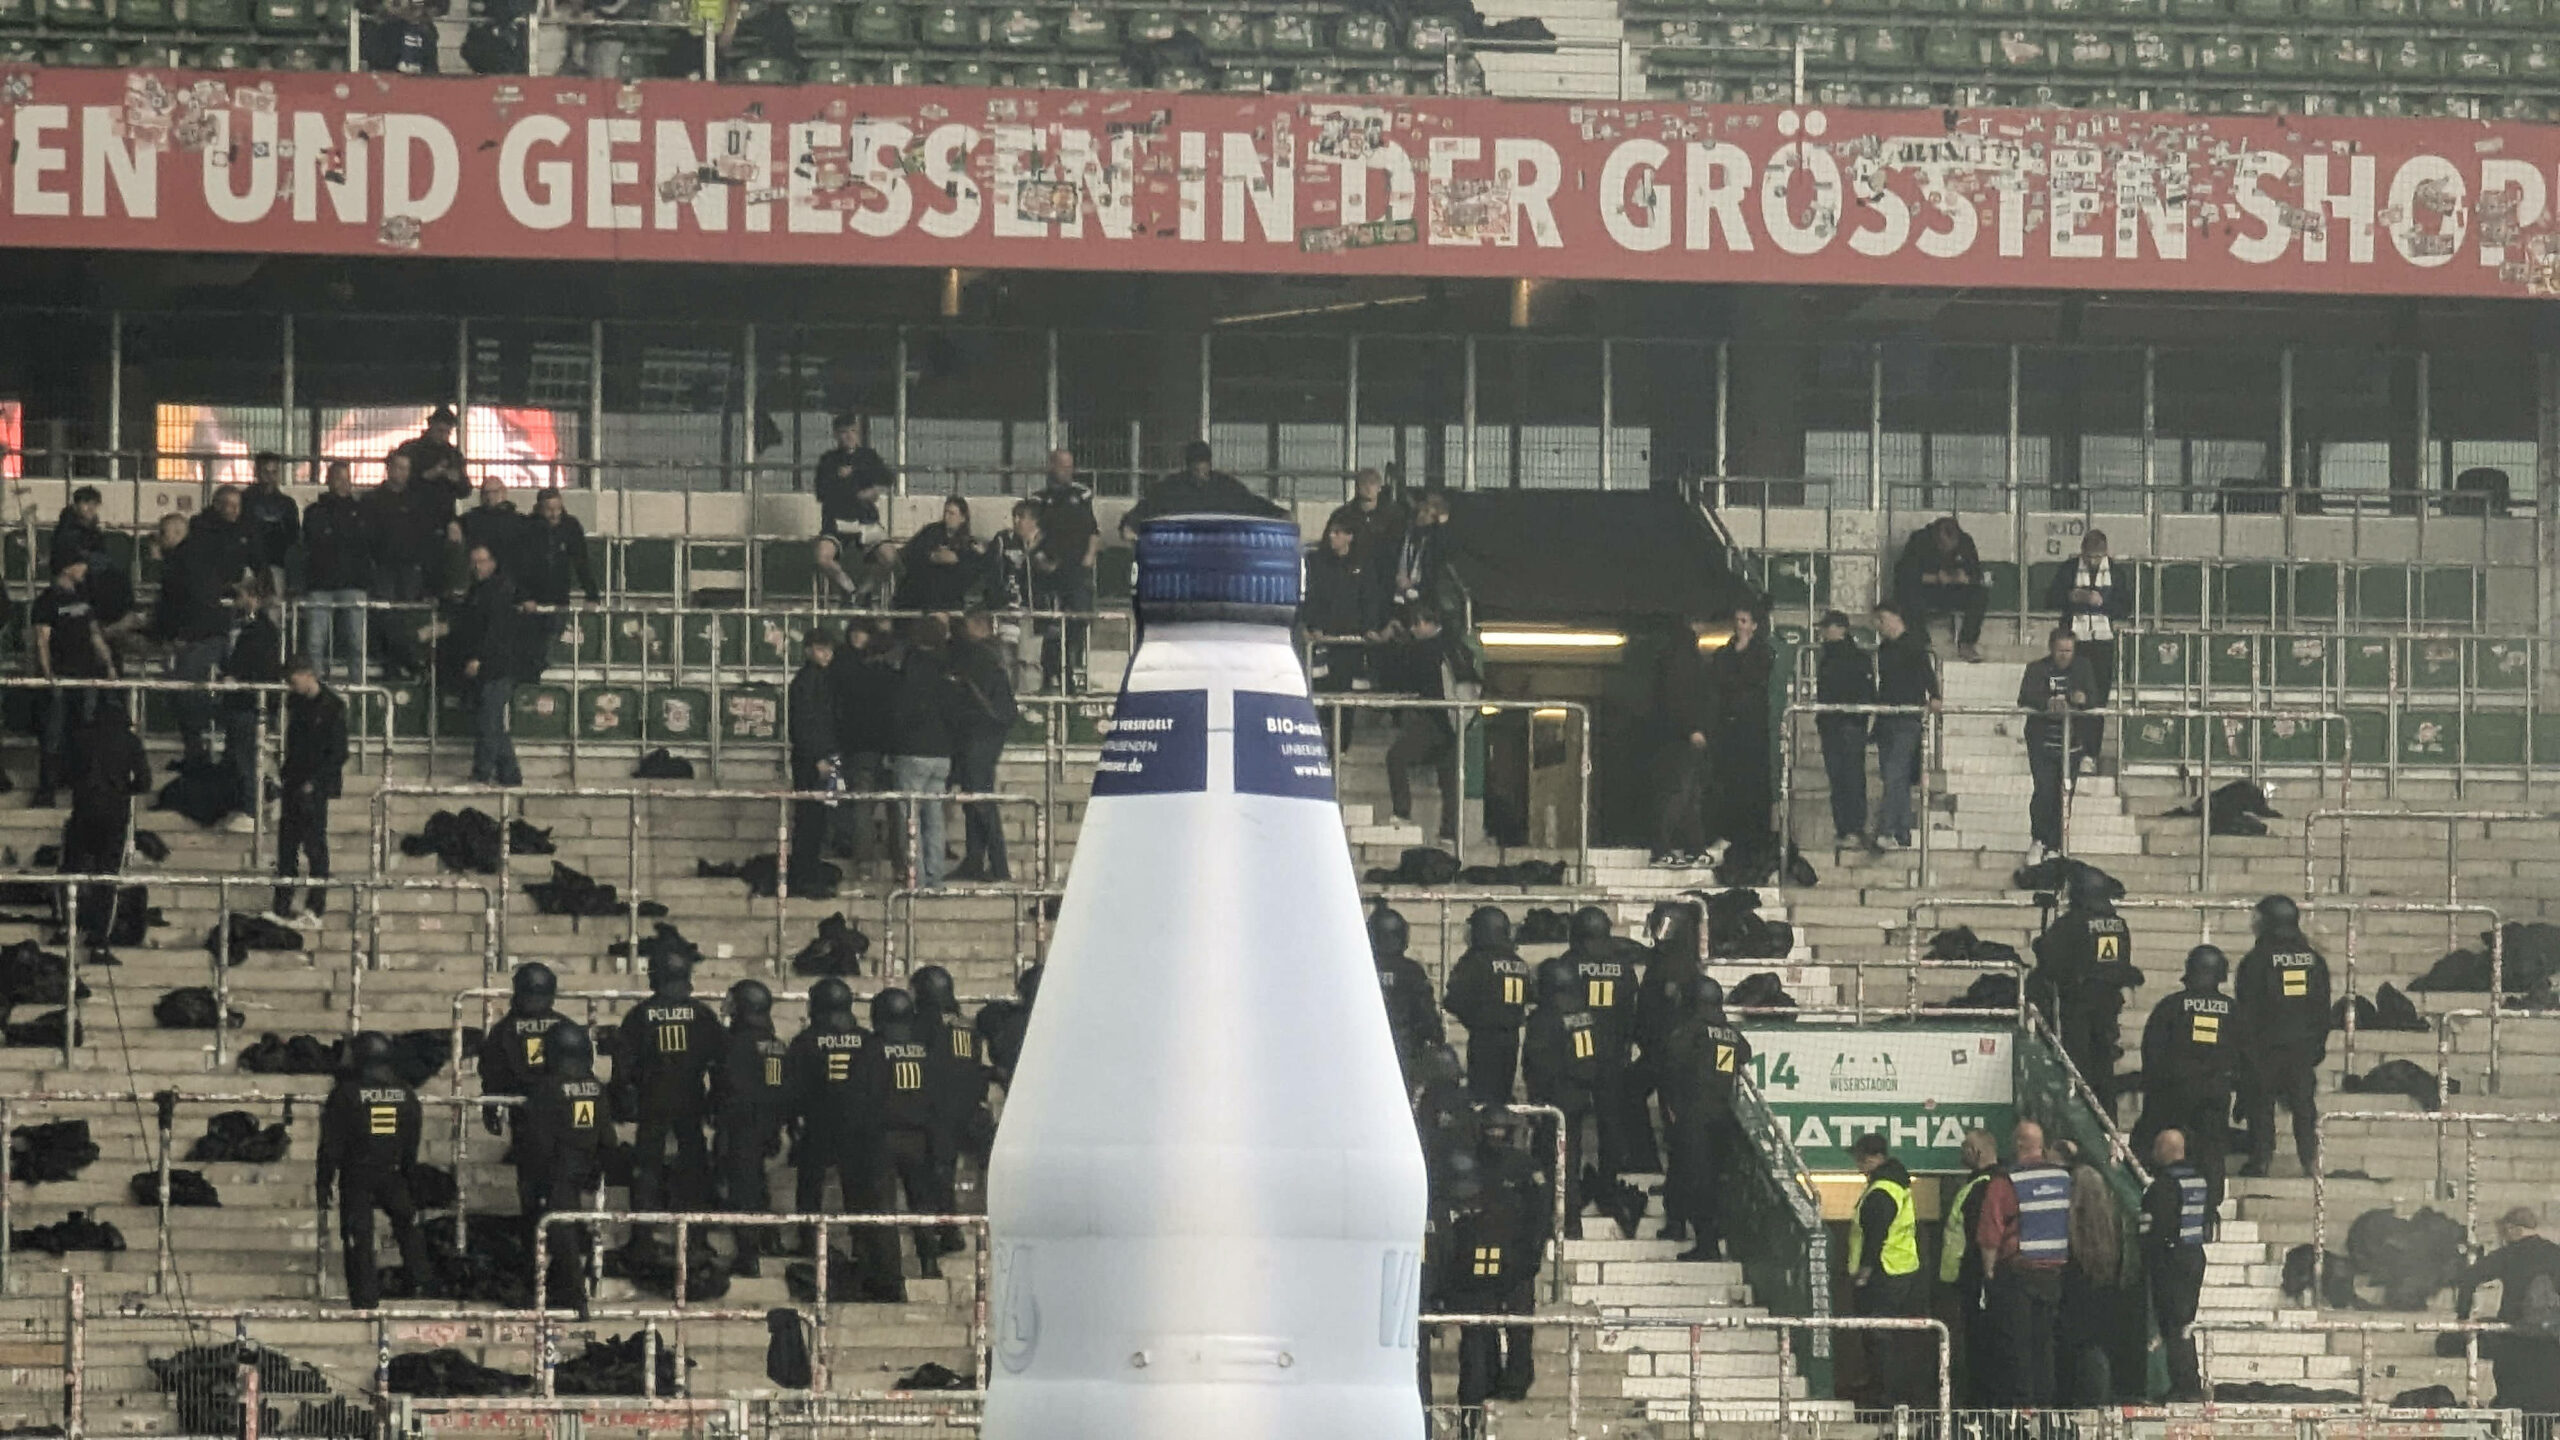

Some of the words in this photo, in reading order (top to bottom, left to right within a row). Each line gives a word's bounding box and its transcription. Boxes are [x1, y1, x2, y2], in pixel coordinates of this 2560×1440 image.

[13, 105, 158, 218] EN
[203, 109, 460, 224] UND
[500, 114, 1134, 240] GENIESSEN
[1179, 131, 1295, 243] IN
[1340, 136, 1564, 248] DER
[1600, 109, 2188, 261] GRÖSSTEN
[2272, 953, 2315, 968] POLIZEI
[1578, 963, 1621, 977] POLIZEI
[2183, 998, 2229, 1014] POLIZEI
[648, 1007, 694, 1022] POLIZEI
[817, 1036, 862, 1050] POLIZEI
[1750, 1052, 1800, 1091] 14
[1829, 1077, 1899, 1092] WESERSTADION
[359, 1088, 406, 1103] POLIZEI
